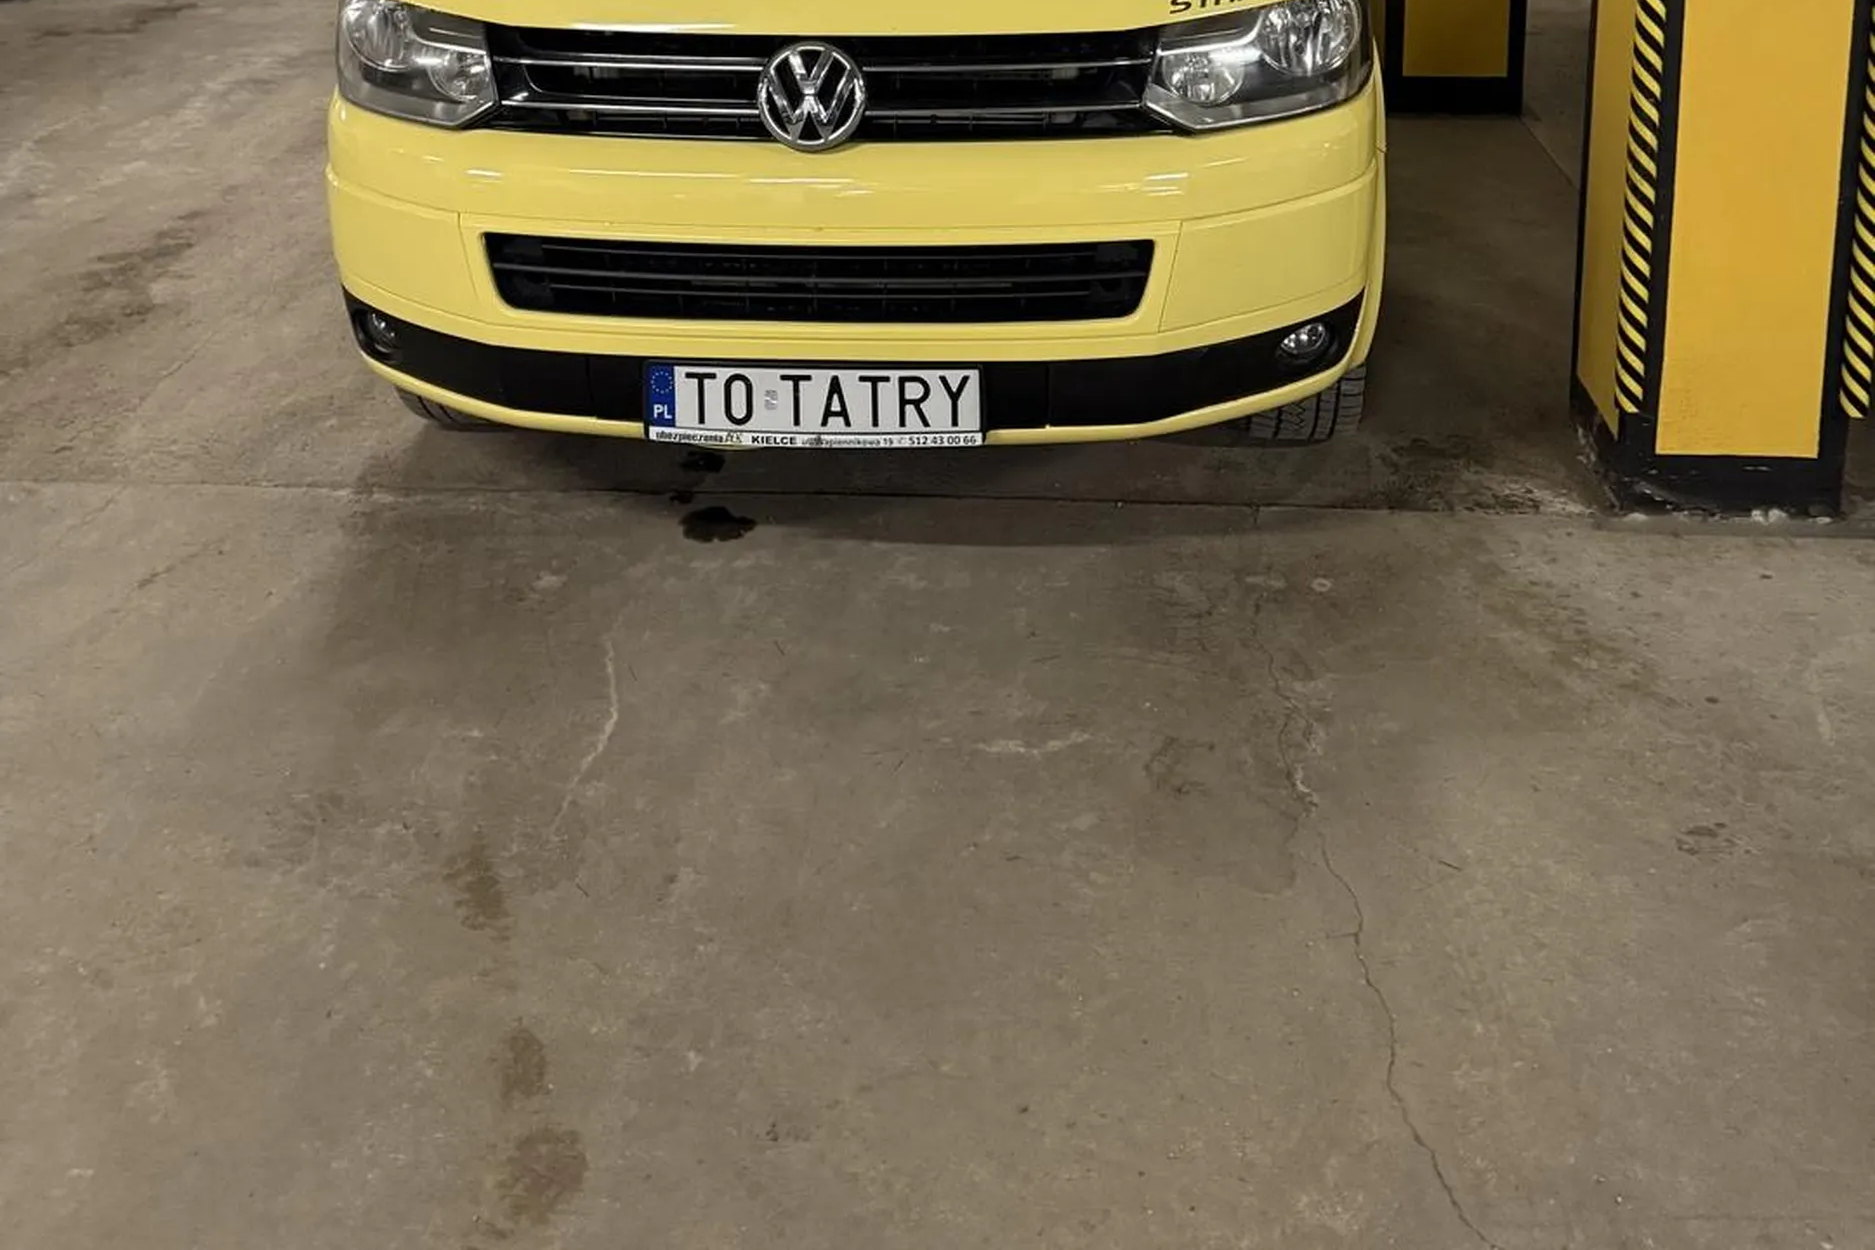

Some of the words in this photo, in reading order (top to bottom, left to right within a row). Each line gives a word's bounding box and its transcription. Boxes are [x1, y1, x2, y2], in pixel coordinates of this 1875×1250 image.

[684, 372, 754, 426] TO
[779, 374, 971, 428] TATRY
[653, 404, 673, 420] PL
[751, 435, 798, 446] KIELCE
[908, 436, 927, 446] 512
[931, 436, 945, 446] 43
[947, 435, 961, 446] 00
[963, 435, 978, 445] 66
